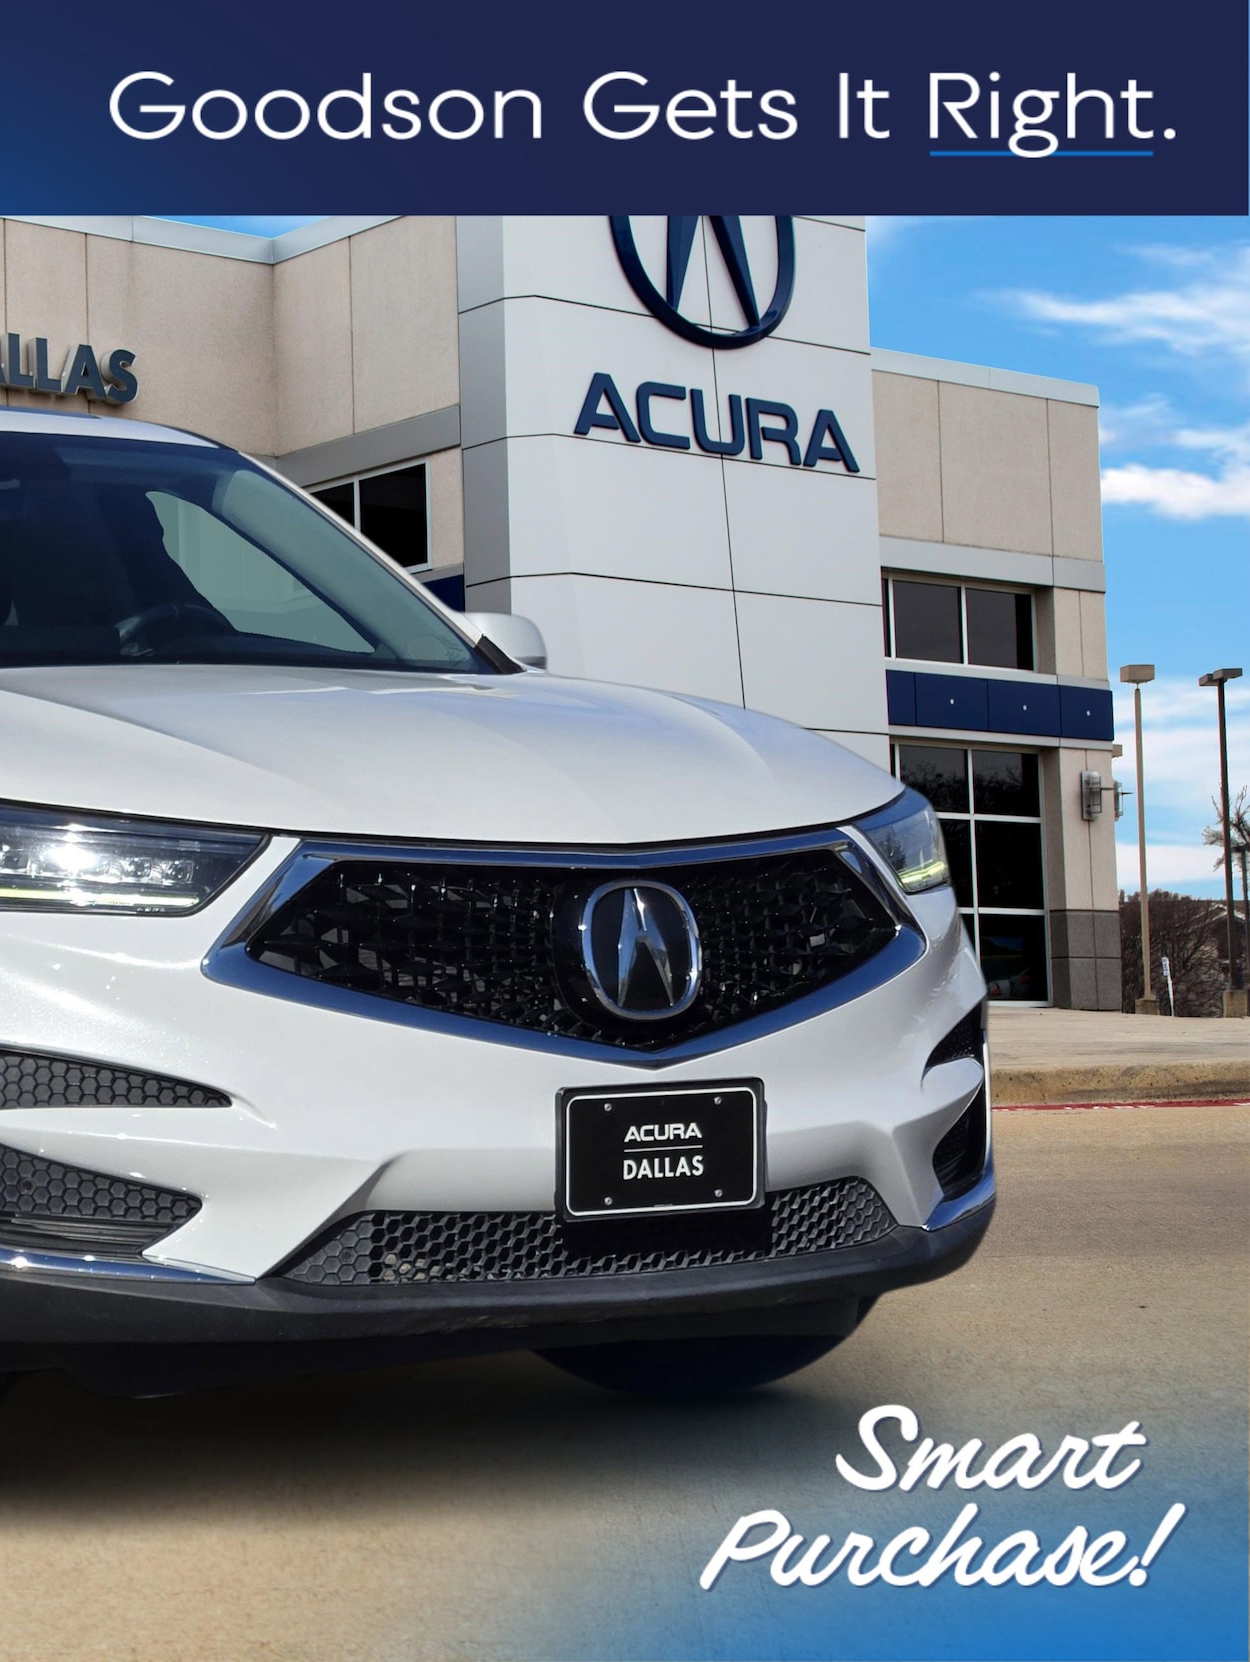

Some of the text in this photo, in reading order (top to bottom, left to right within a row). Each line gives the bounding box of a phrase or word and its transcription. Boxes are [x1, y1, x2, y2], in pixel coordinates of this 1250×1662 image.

[573, 372, 860, 473] ACURA
[624, 1122, 702, 1143] ACURA
[623, 1155, 704, 1180] DALLAS
